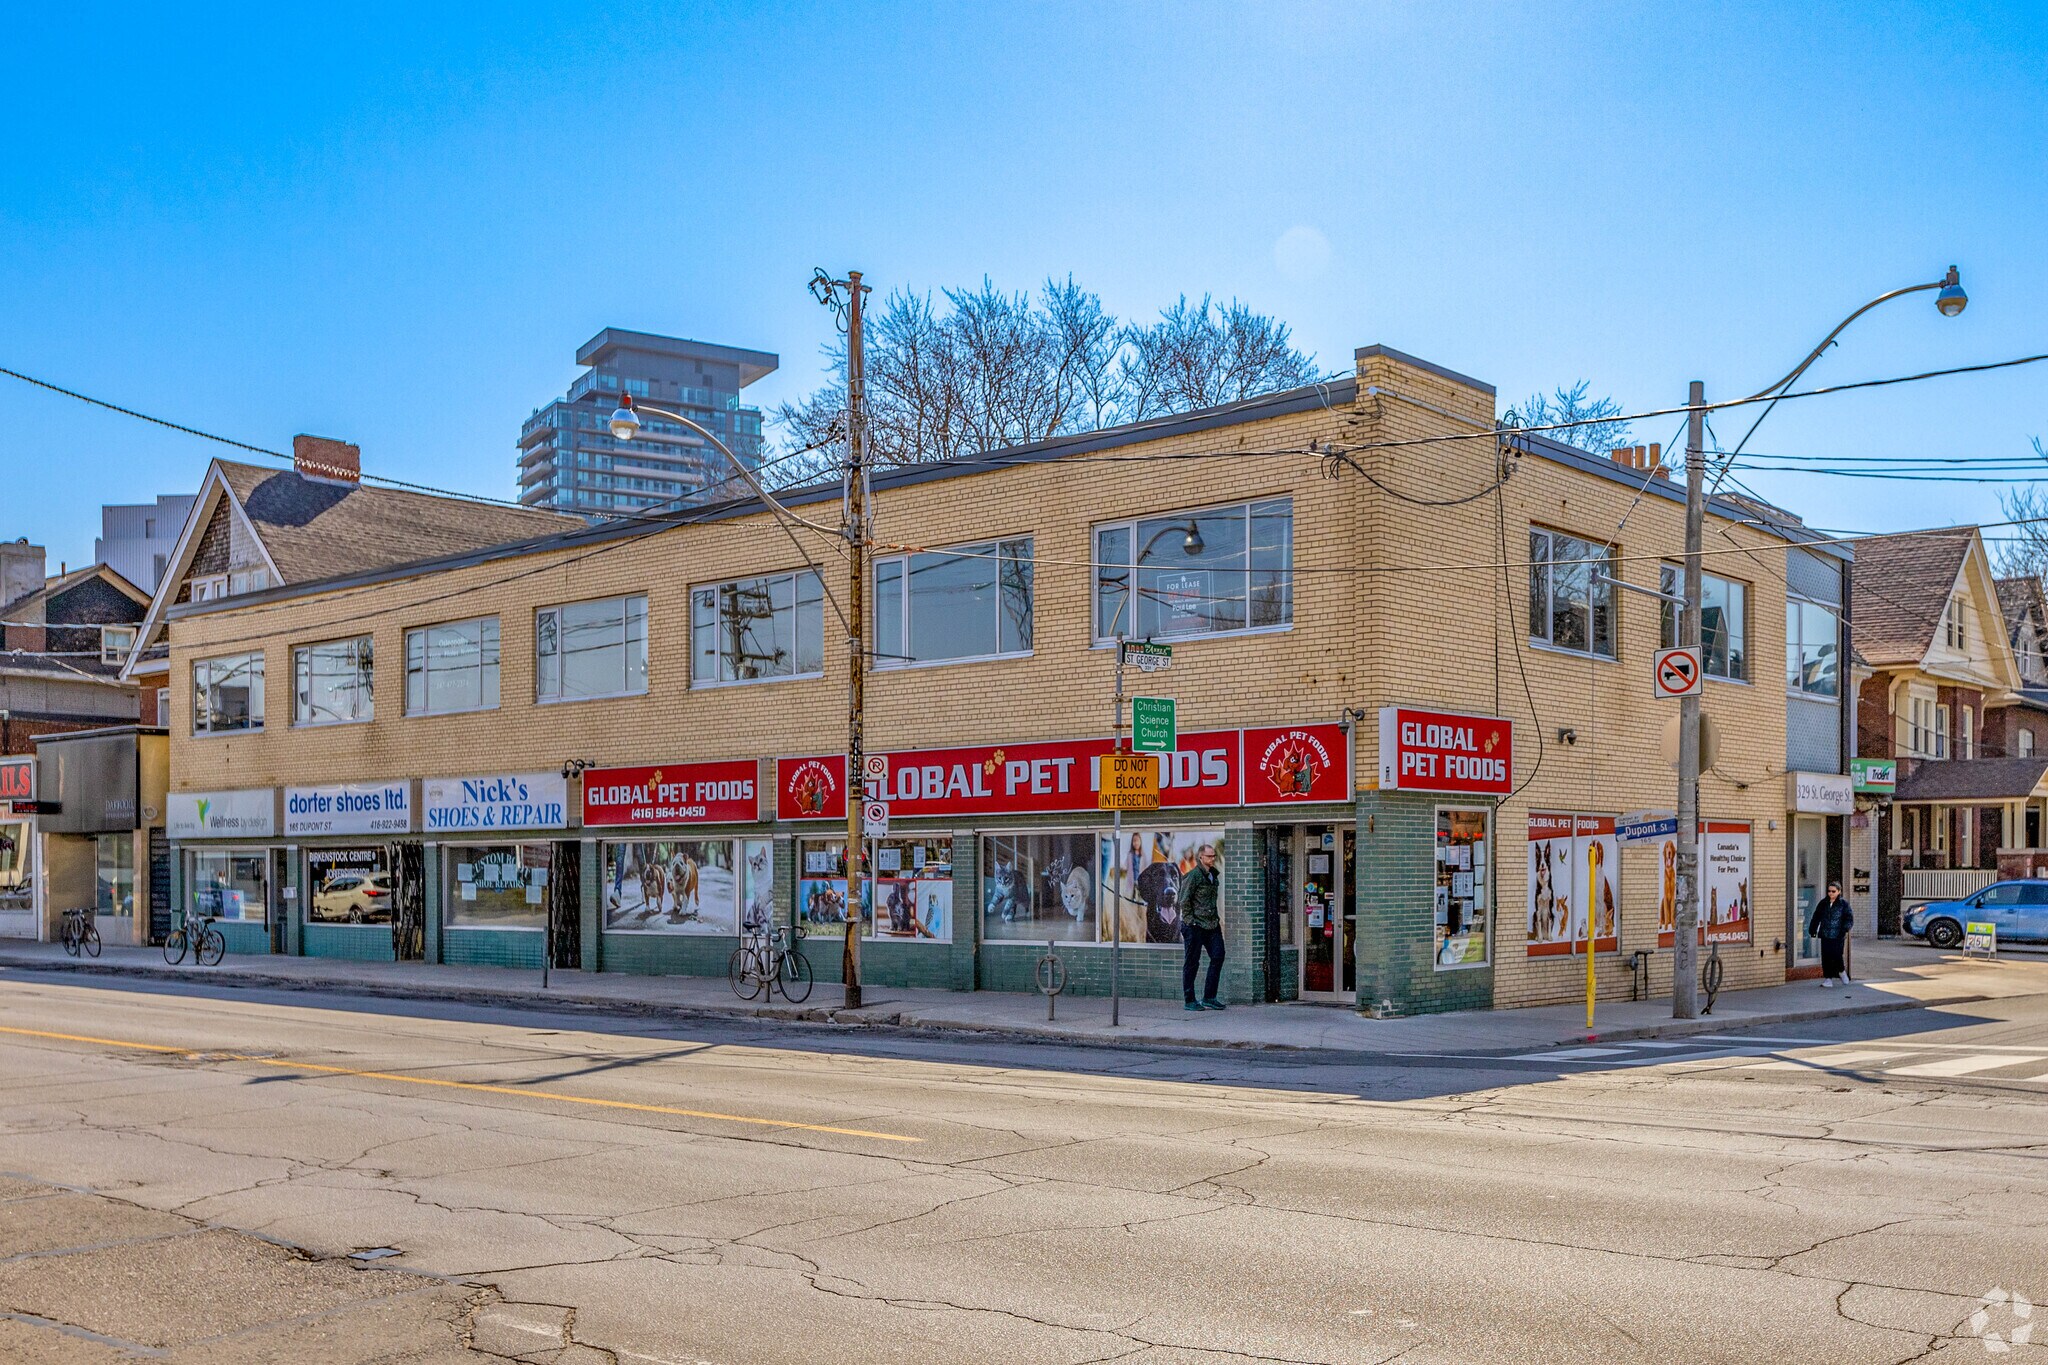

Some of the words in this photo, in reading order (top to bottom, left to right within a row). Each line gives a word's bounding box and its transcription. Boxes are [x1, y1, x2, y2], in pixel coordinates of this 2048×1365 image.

[1181, 581, 1200, 589] LEASE
[1136, 655, 1160, 666] GEORGE
[1162, 657, 1170, 667] ST
[1137, 701, 1172, 712] Christian
[1139, 714, 1169, 725] Science
[1141, 728, 1168, 738] Church
[1401, 721, 1478, 752] GLOBAL
[1259, 735, 1288, 771] GLOBAL
[1289, 731, 1308, 740] PET
[1308, 735, 1331, 768] FOODS
[1114, 759, 1128, 771] DO
[1130, 759, 1149, 771] NOT
[1401, 751, 1439, 778] PET
[1445, 755, 1506, 782] FOODS
[0, 765, 31, 796] ILS
[788, 763, 807, 793] GLOBAL
[808, 760, 820, 769] PET
[820, 764, 836, 792] FOODS
[1005, 757, 1075, 796] PET
[1872, 768, 1890, 780] Trident
[1116, 776, 1147, 789] BLOCK
[461, 777, 529, 804] Nick's
[588, 785, 653, 806] GLOBAL
[657, 782, 690, 803] PET
[695, 779, 754, 802] FOODS
[1797, 784, 1810, 799] 329
[1819, 785, 1844, 808] George
[289, 792, 332, 814] dorfer
[336, 791, 381, 812] shoes
[384, 787, 408, 810] ltd.
[1101, 794, 1158, 807] INTERSECTION
[428, 806, 480, 828] SHOES
[482, 805, 496, 826] &
[500, 802, 562, 825] REPAIR
[631, 808, 654, 820] (416)
[209, 816, 240, 829] Wellness
[247, 816, 268, 830] design
[299, 821, 324, 832] DUPONT
[1528, 817, 1557, 828] GLOBAL
[1557, 819, 1572, 829] PET
[1577, 820, 1600, 830] FOODS
[1625, 823, 1657, 837] Dupont
[1660, 823, 1668, 832] St
[1717, 843, 1740, 851] Canada's
[309, 851, 349, 863] BIRKENSTOCK
[349, 850, 372, 862] CENTRE
[1710, 855, 1730, 863] Healthy
[1730, 854, 1747, 862] Choice
[475, 880, 495, 888] SHOE
[495, 880, 525, 888] REPAIRS
